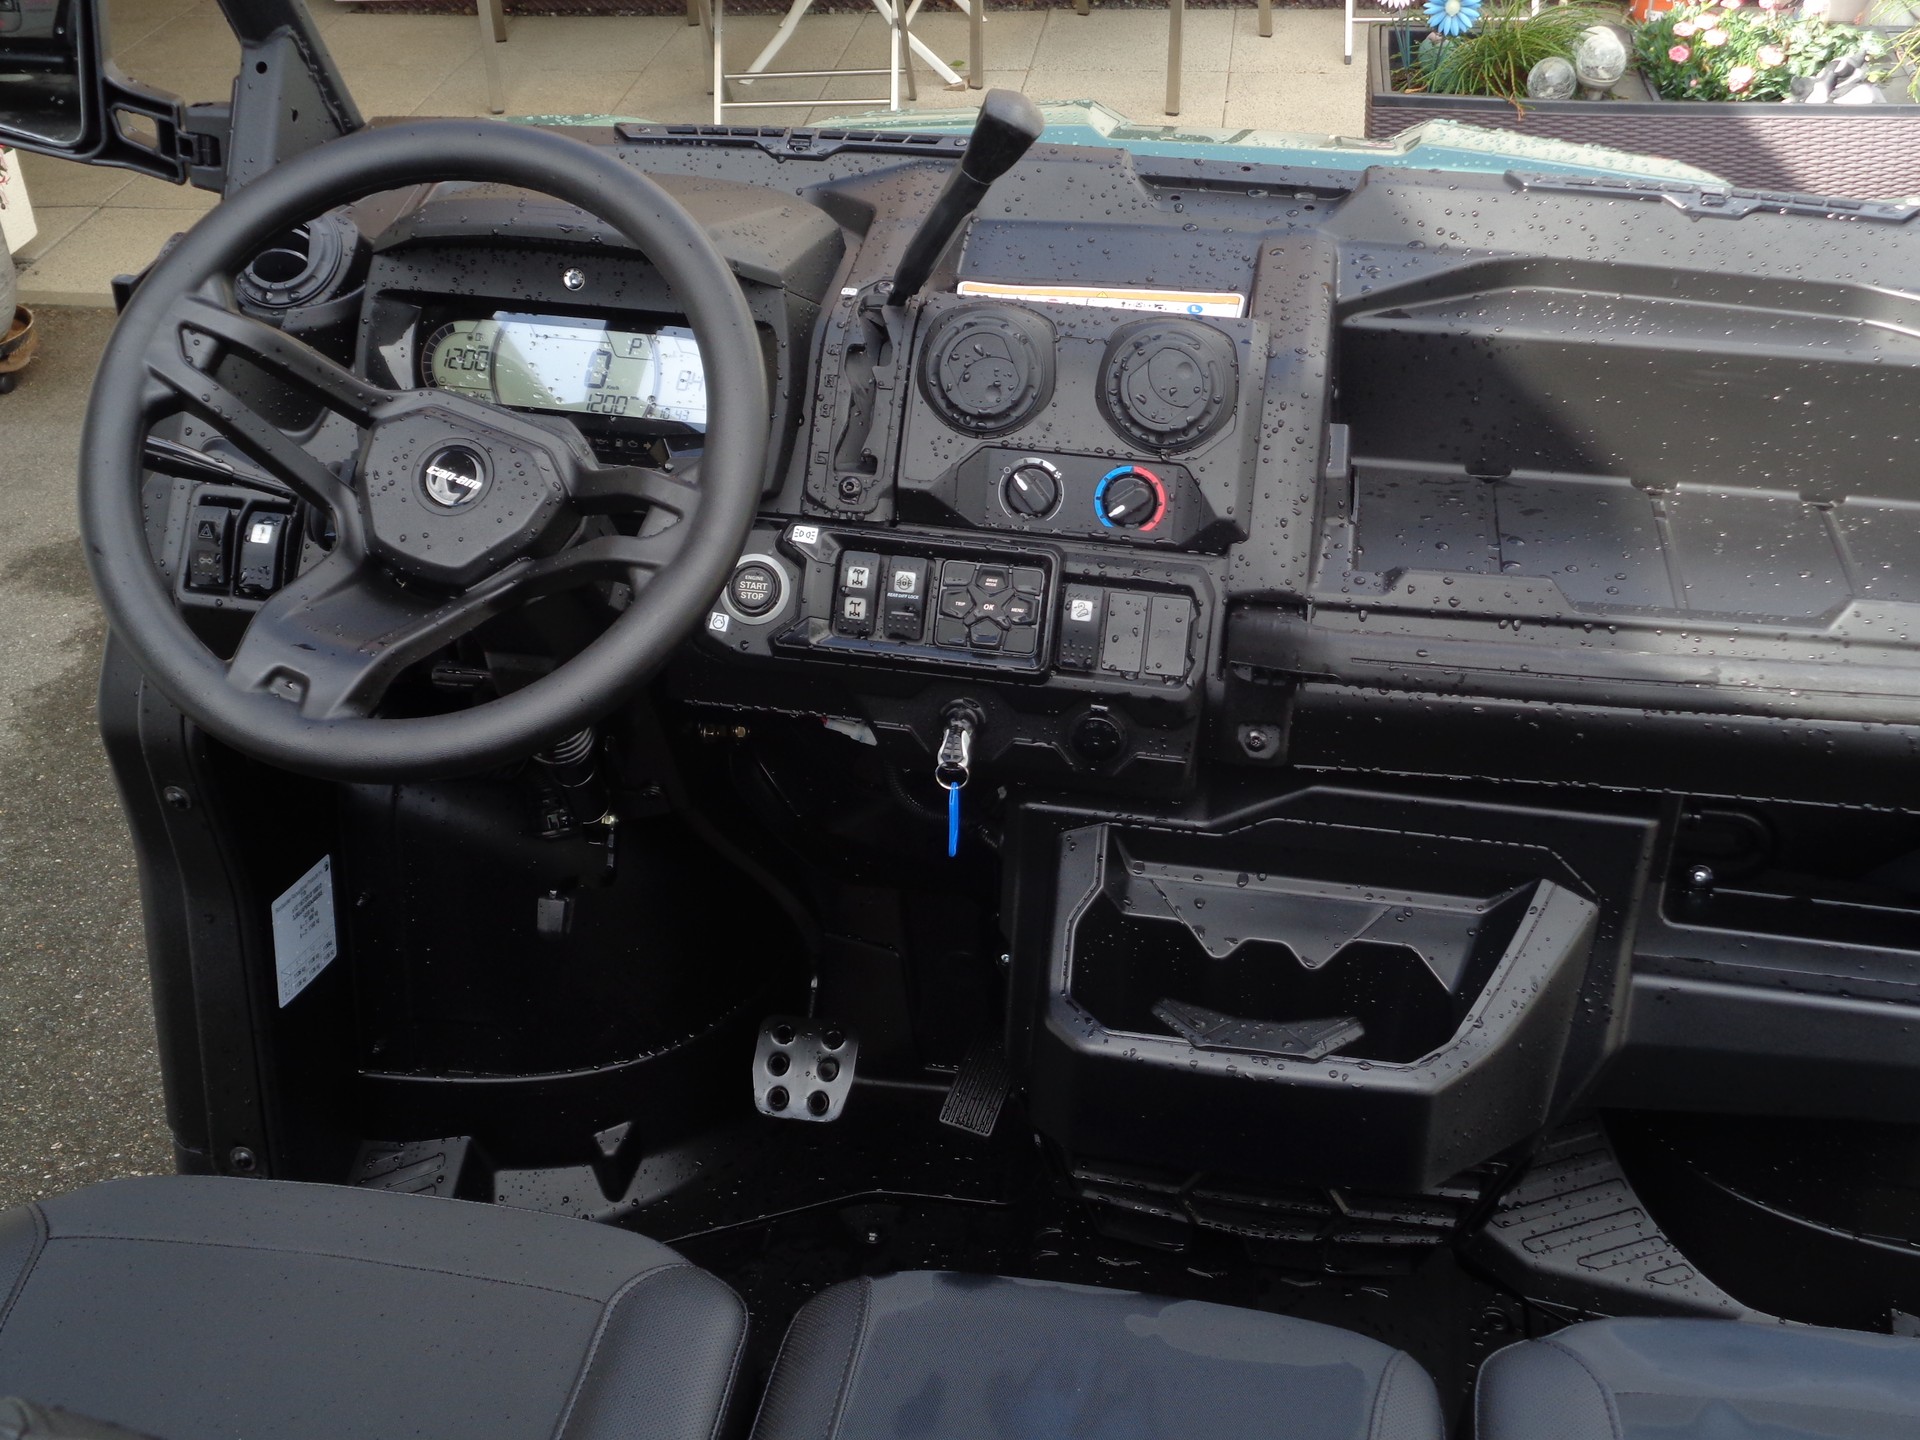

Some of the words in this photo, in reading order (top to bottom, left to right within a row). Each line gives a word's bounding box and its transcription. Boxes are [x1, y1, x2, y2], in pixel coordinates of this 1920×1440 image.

[629, 338, 642, 355] P
[443, 347, 489, 372] 1200
[584, 349, 613, 389] 0
[586, 393, 629, 415] 1200
[740, 581, 768, 590] START
[740, 591, 764, 600] STOP
